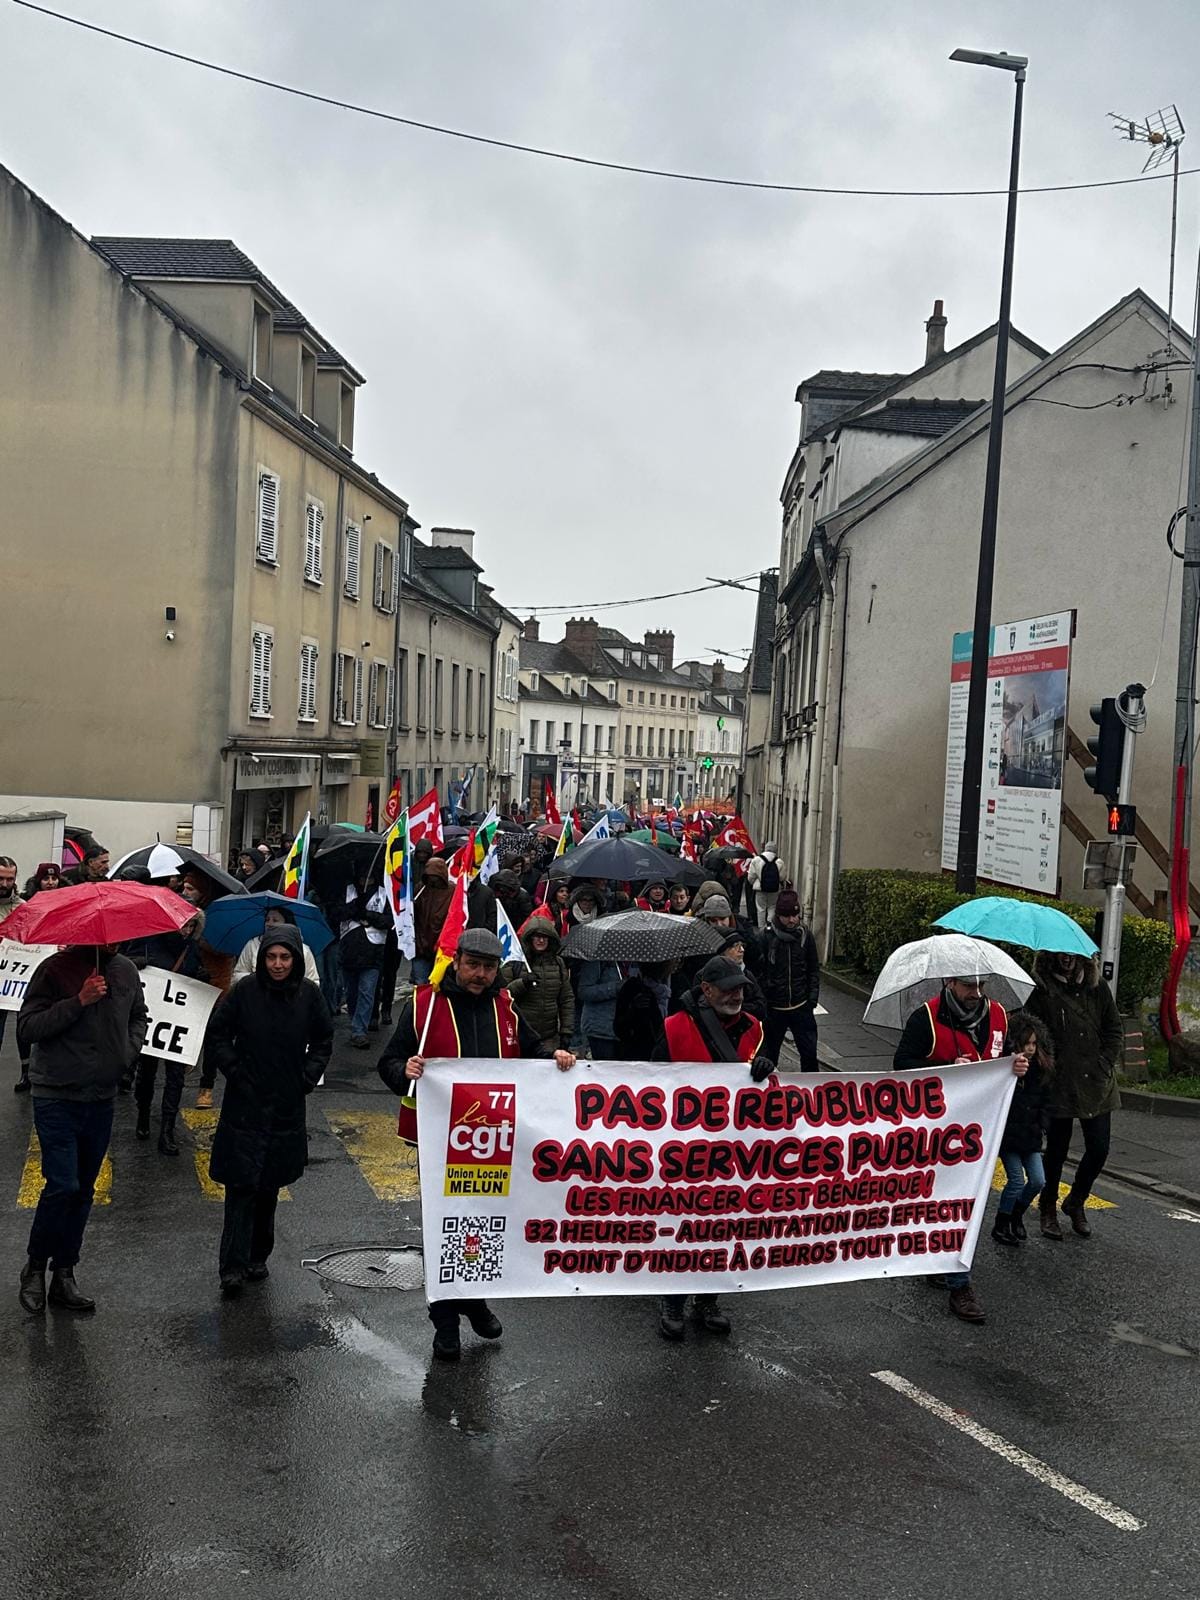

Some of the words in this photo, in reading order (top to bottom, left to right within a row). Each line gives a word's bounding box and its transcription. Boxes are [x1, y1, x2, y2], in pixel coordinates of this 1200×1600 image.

[11, 961, 30, 975] 77
[0, 979, 28, 999] UTT
[163, 979, 187, 1006] Le
[488, 1091, 514, 1109] 77
[575, 1084, 666, 1131] PAS
[671, 1086, 730, 1132] DE
[734, 1075, 946, 1131] RÉPUBLIQUE
[450, 1119, 513, 1159] cgt
[533, 1138, 653, 1183] SANS
[659, 1136, 844, 1183] SERVICES
[848, 1123, 983, 1174] PUBLICS
[447, 1167, 474, 1179] Union
[477, 1168, 508, 1180] Locale
[450, 1180, 503, 1194] MELUN
[566, 1185, 615, 1216] LES
[614, 1186, 745, 1216] FINANCER
[745, 1182, 812, 1213] C'EST
[813, 1169, 921, 1209] BÉNÉFIQUE
[921, 1169, 935, 1198] !
[525, 1219, 557, 1243] 32
[560, 1220, 656, 1243] HEURES
[675, 1208, 850, 1242] AUGMENTATION
[851, 1205, 889, 1231] DES
[544, 1249, 622, 1274] POINT
[623, 1248, 728, 1274] D'INDICE
[729, 1242, 748, 1271] À
[750, 1246, 766, 1269] 6
[767, 1241, 838, 1268] EUROS
[839, 1233, 895, 1261] TOUT
[897, 1231, 928, 1256] DE
[928, 1229, 967, 1253] SUI
